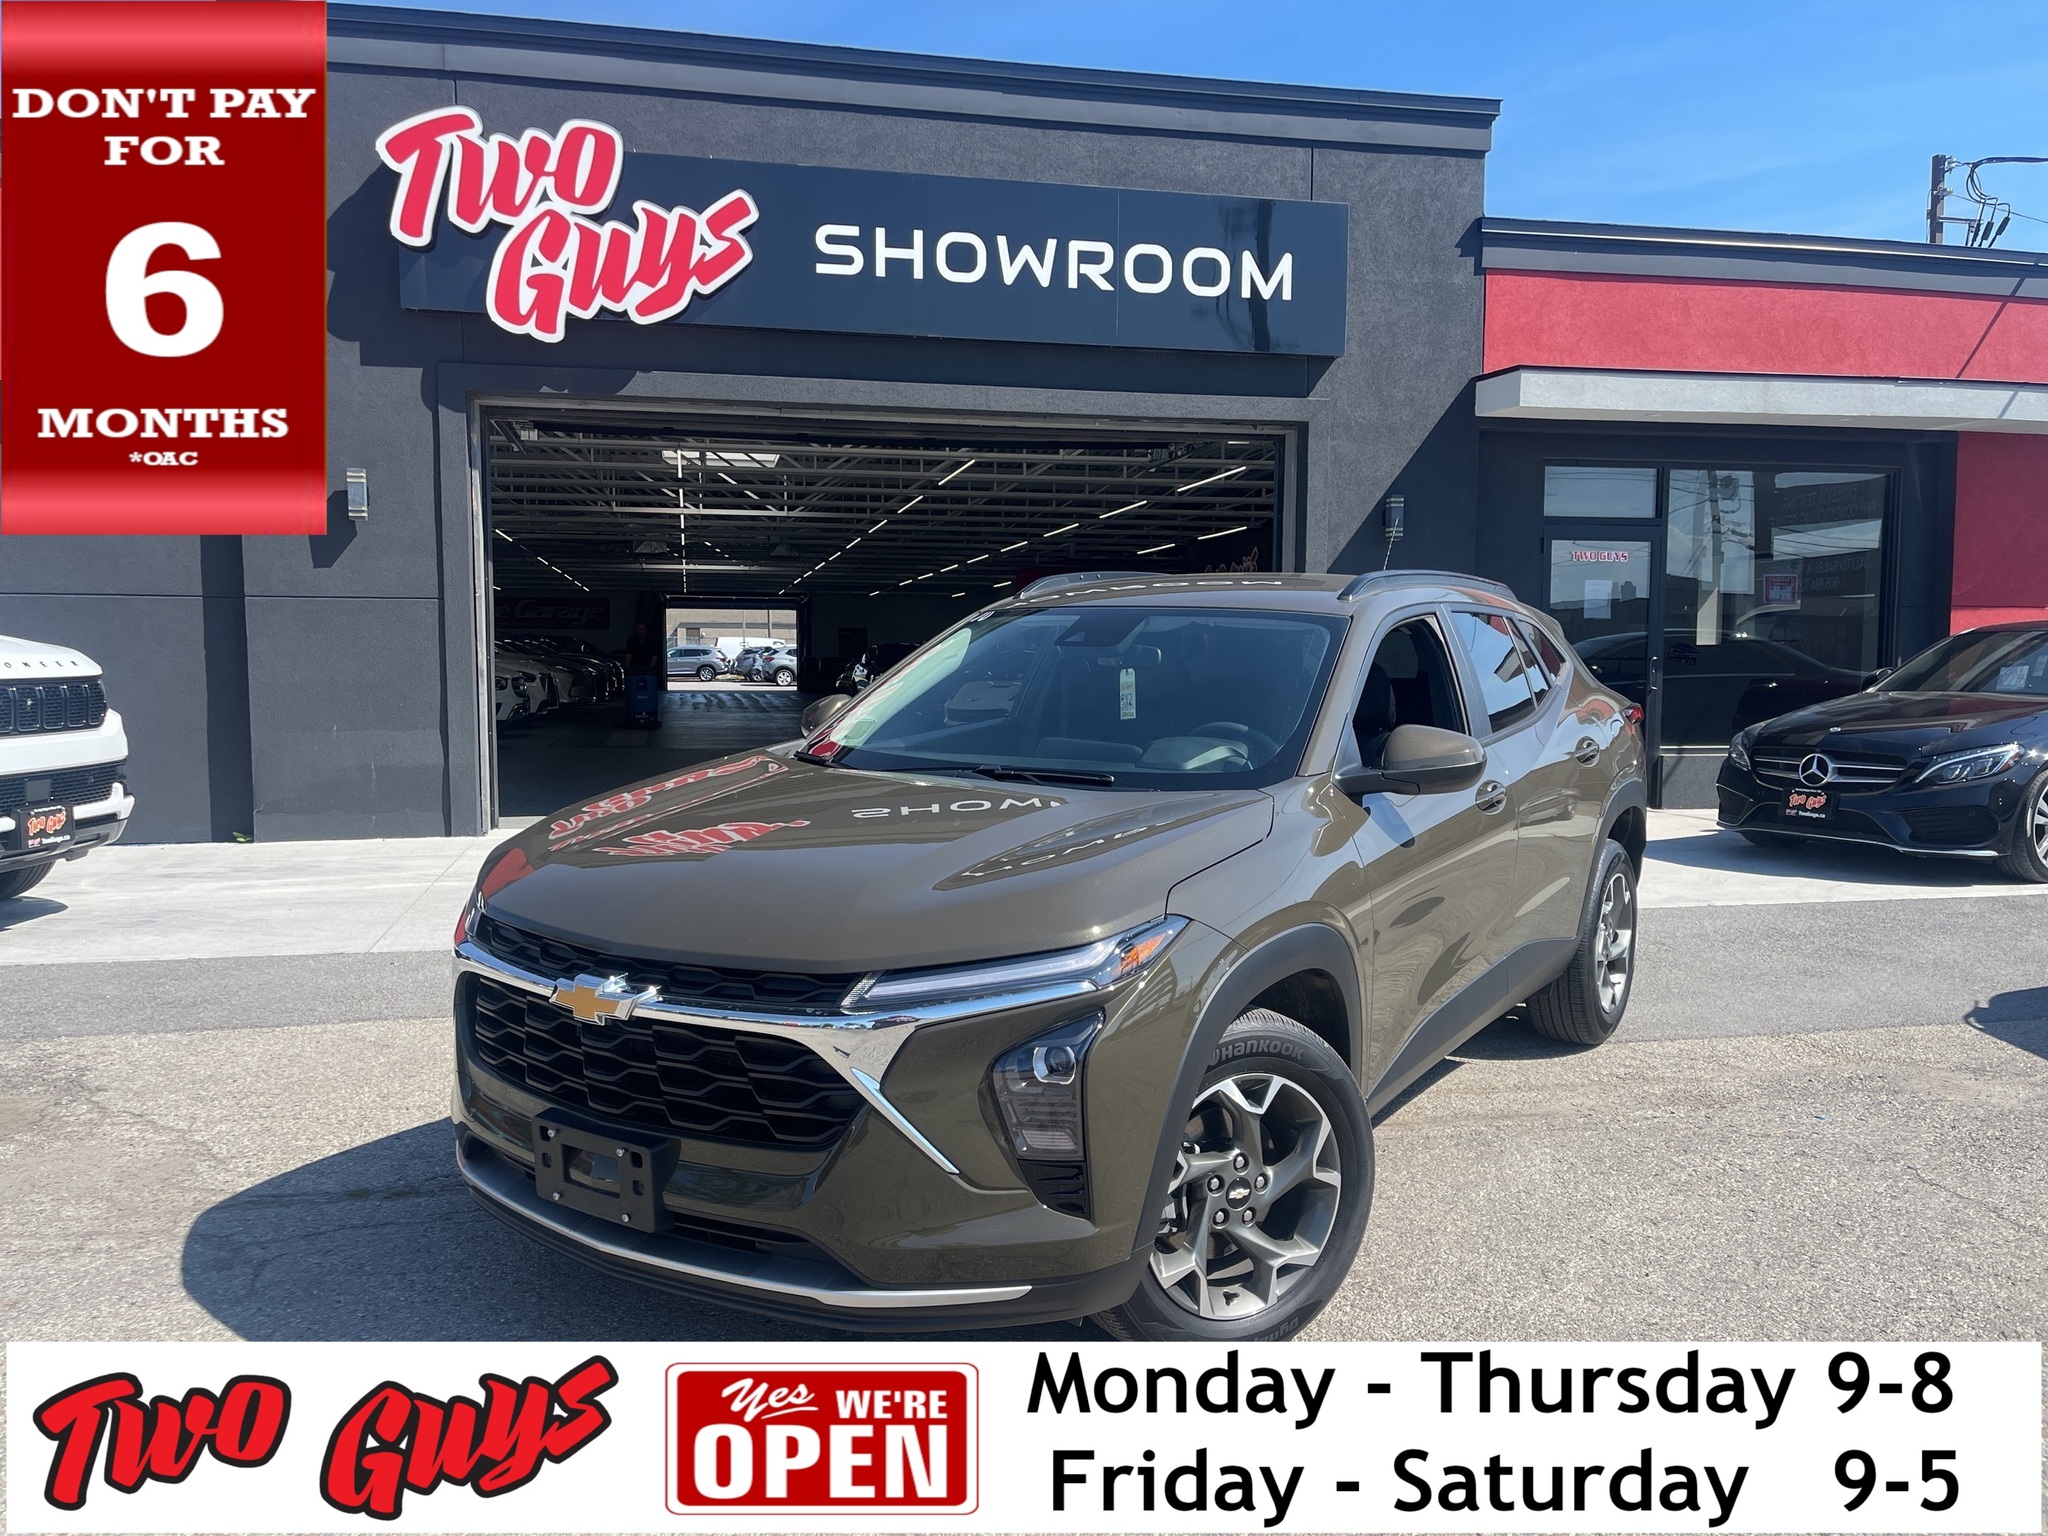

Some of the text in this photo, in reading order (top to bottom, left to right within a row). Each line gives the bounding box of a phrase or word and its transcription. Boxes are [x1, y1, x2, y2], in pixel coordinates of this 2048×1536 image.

[378, 107, 622, 244] Two
[488, 190, 757, 340] Guys
[815, 224, 1293, 303] SHOWROOM
[1571, 550, 1628, 562] TWO GUYS
[4, 660, 79, 669] ONEER
